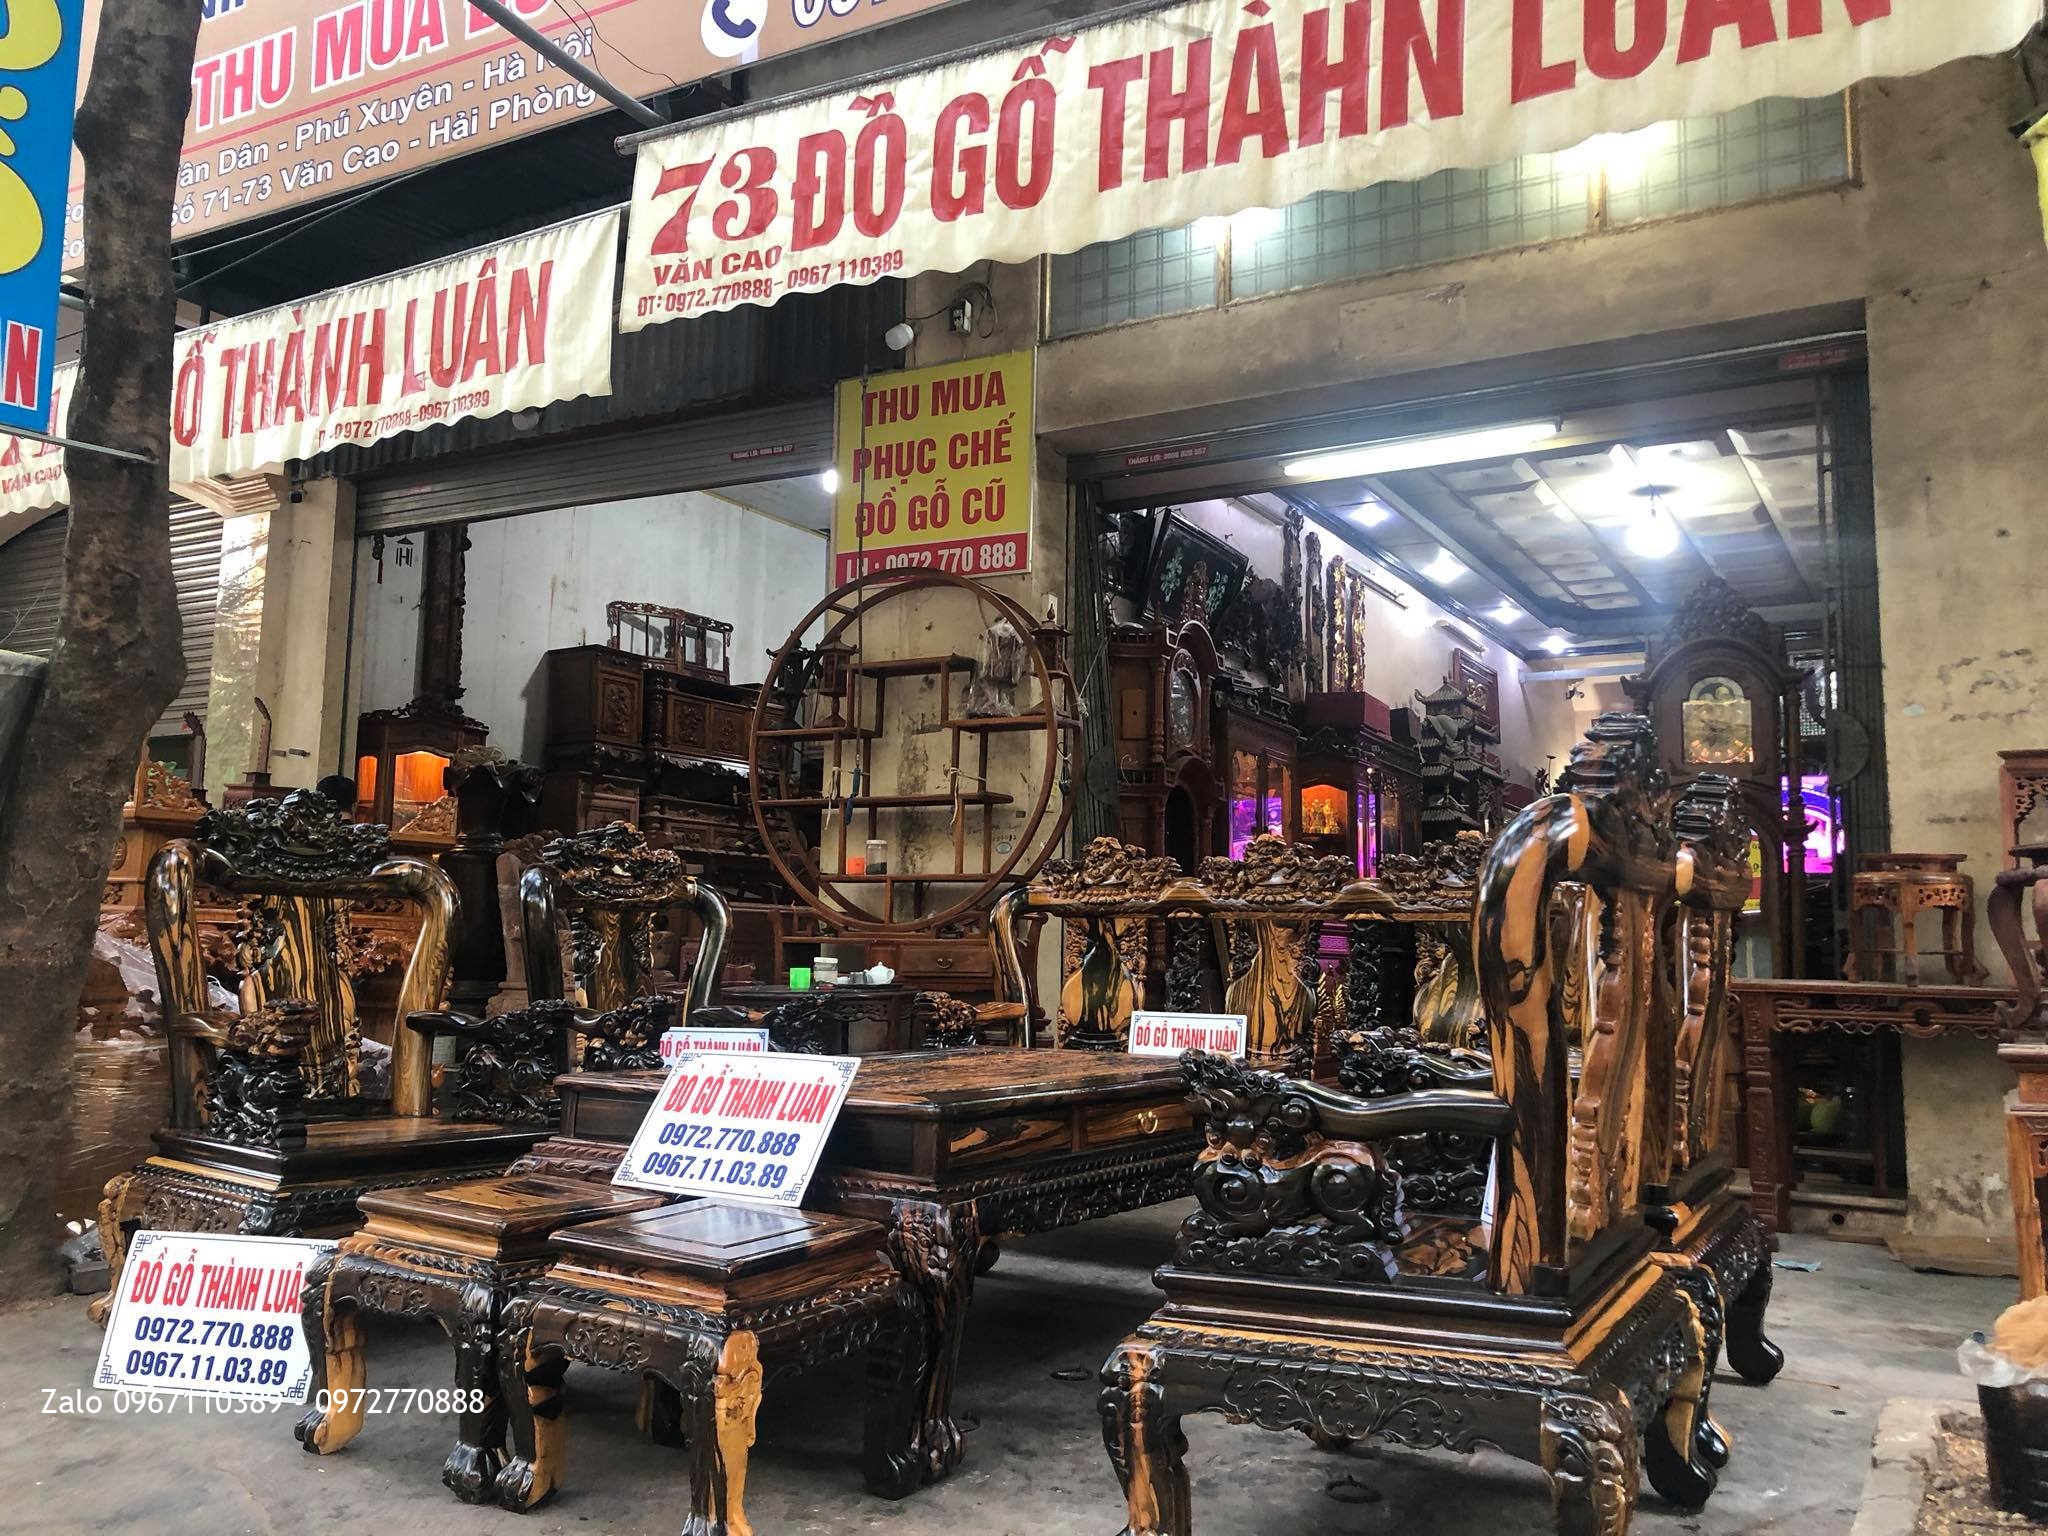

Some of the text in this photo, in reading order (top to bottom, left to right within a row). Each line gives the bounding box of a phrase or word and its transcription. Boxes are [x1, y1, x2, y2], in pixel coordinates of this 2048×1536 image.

[191, 27, 297, 132] THU
[312, 0, 447, 92] MUA
[178, 160, 210, 189] ân
[217, 140, 270, 177] Dân
[277, 141, 289, 151] -
[294, 110, 351, 152] Phú
[356, 80, 453, 133] Xuyên
[462, 79, 475, 91] -
[482, 51, 527, 91] Hà
[650, 146, 779, 256] 73
[790, 91, 907, 253] ĐỒ
[929, 35, 1076, 223] GỖ
[202, 173, 273, 218] 71-73
[279, 159, 334, 193] Văn
[341, 139, 401, 174] Cao
[407, 138, 421, 149] -
[429, 106, 480, 148] Hải
[488, 81, 598, 131] Phòng
[653, 245, 783, 288] VĂN CAO
[837, 249, 904, 282] 110389
[173, 256, 555, 448] Ỗ THÀNH LUÂN
[863, 369, 1007, 428] THU MUA
[852, 411, 1016, 487] PHỤC CHẾ
[854, 477, 1007, 538] ĐỒ GỖ CŨ
[937, 546, 974, 574] 770
[979, 541, 1017, 569] 888
[1135, 1020, 1239, 1051] ĐỒ GỖ THÀNH LUÂN
[776, 1076, 837, 1124] LUÂN
[657, 1121, 801, 1157] 0972.770.888
[642, 1151, 789, 1190] 0967.11.03.89
[129, 1247, 309, 1315] ĐỒ GỖ THÀNH LUÂ
[134, 1315, 294, 1352] 0972.770.888
[125, 1349, 289, 1386] 0967.11.03.89
